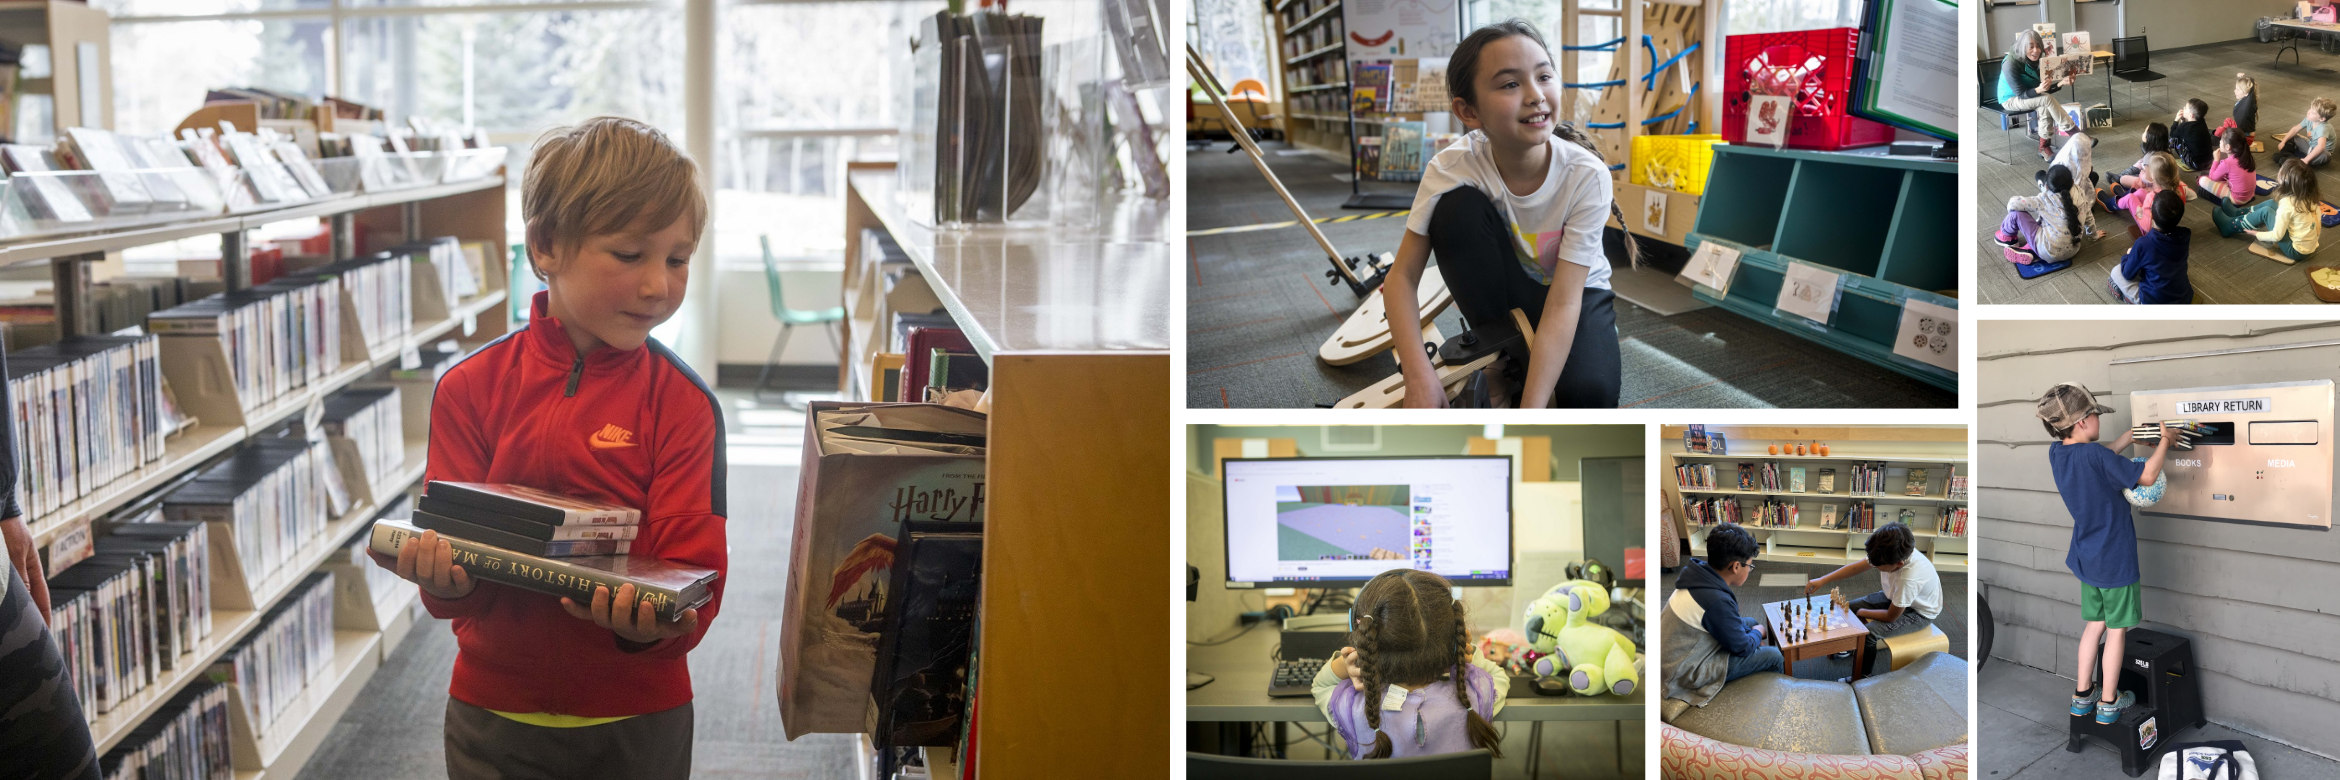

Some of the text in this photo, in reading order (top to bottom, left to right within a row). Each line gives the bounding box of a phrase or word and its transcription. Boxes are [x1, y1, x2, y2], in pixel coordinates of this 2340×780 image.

[2183, 400, 2262, 413] LIBRARY RETURN
[599, 423, 633, 442] NIKE
[2175, 459, 2202, 467] BOOKS
[2267, 459, 2296, 468] MEDIA
[889, 486, 968, 522] Harry
[483, 561, 500, 571] OF
[507, 562, 591, 592] HISTORY
